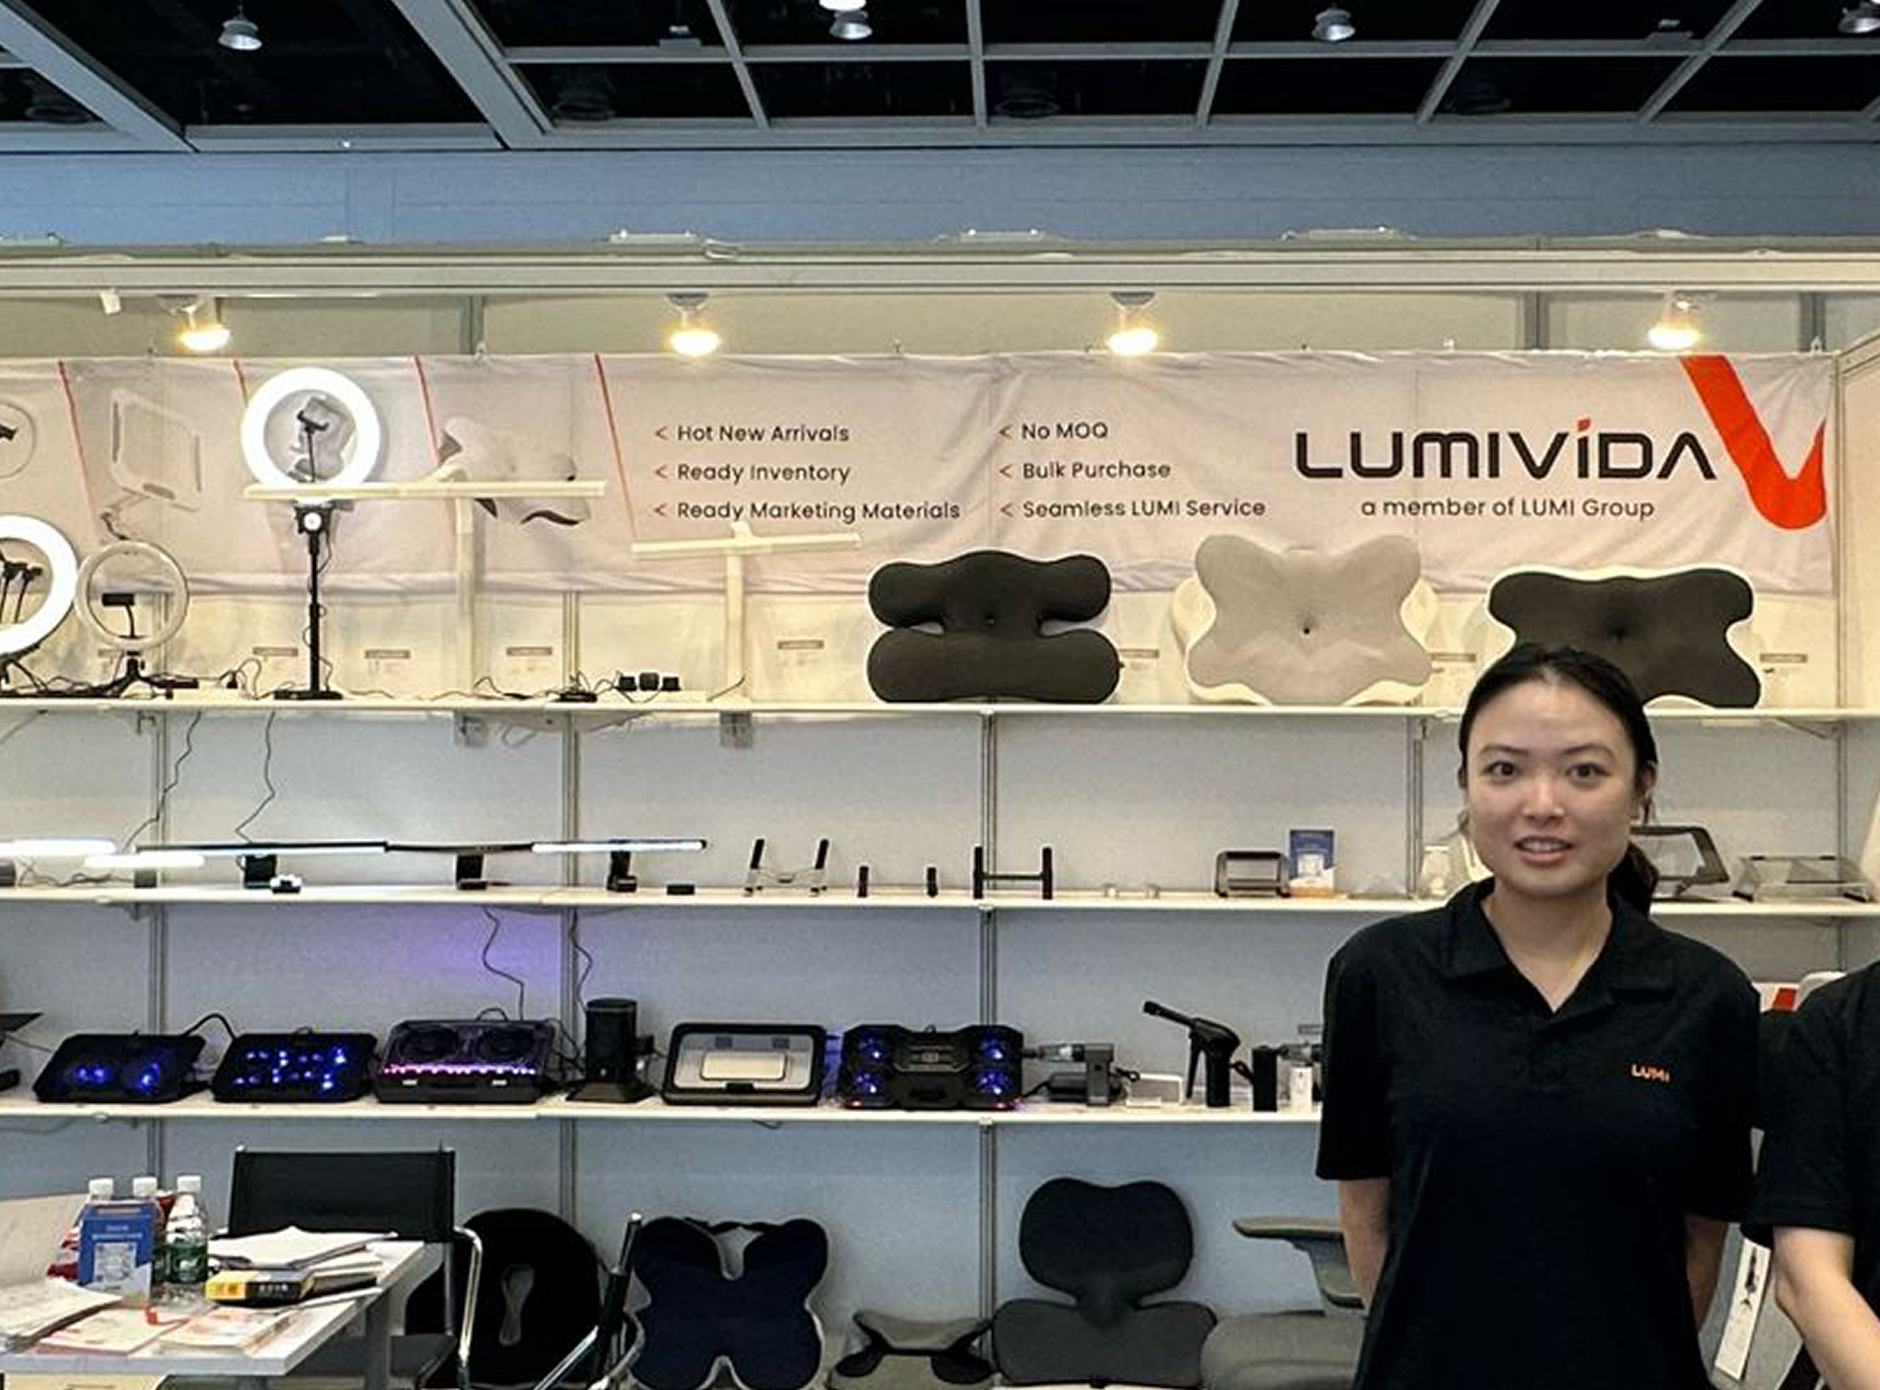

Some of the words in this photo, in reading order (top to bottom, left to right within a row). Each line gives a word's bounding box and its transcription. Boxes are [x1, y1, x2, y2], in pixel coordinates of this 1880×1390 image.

[677, 425, 713, 442] Hot
[719, 425, 765, 442] New
[770, 424, 850, 442] Arrivals
[1022, 424, 1051, 440] No
[677, 463, 744, 485] Ready
[750, 463, 851, 485] Inventory
[1023, 462, 1066, 479] Bulk
[1072, 459, 1172, 478] Purchase
[677, 501, 744, 521] Ready
[750, 502, 856, 525] Marketing
[862, 501, 961, 520] Materials
[1023, 500, 1126, 519] Seamless
[1131, 499, 1181, 517] LUMI
[1186, 498, 1266, 518] Service
[1360, 501, 1376, 516] a
[1382, 497, 1486, 517] member
[1492, 497, 1516, 516] of
[1521, 498, 1575, 516] LUMI
[1581, 498, 1656, 522] Group
